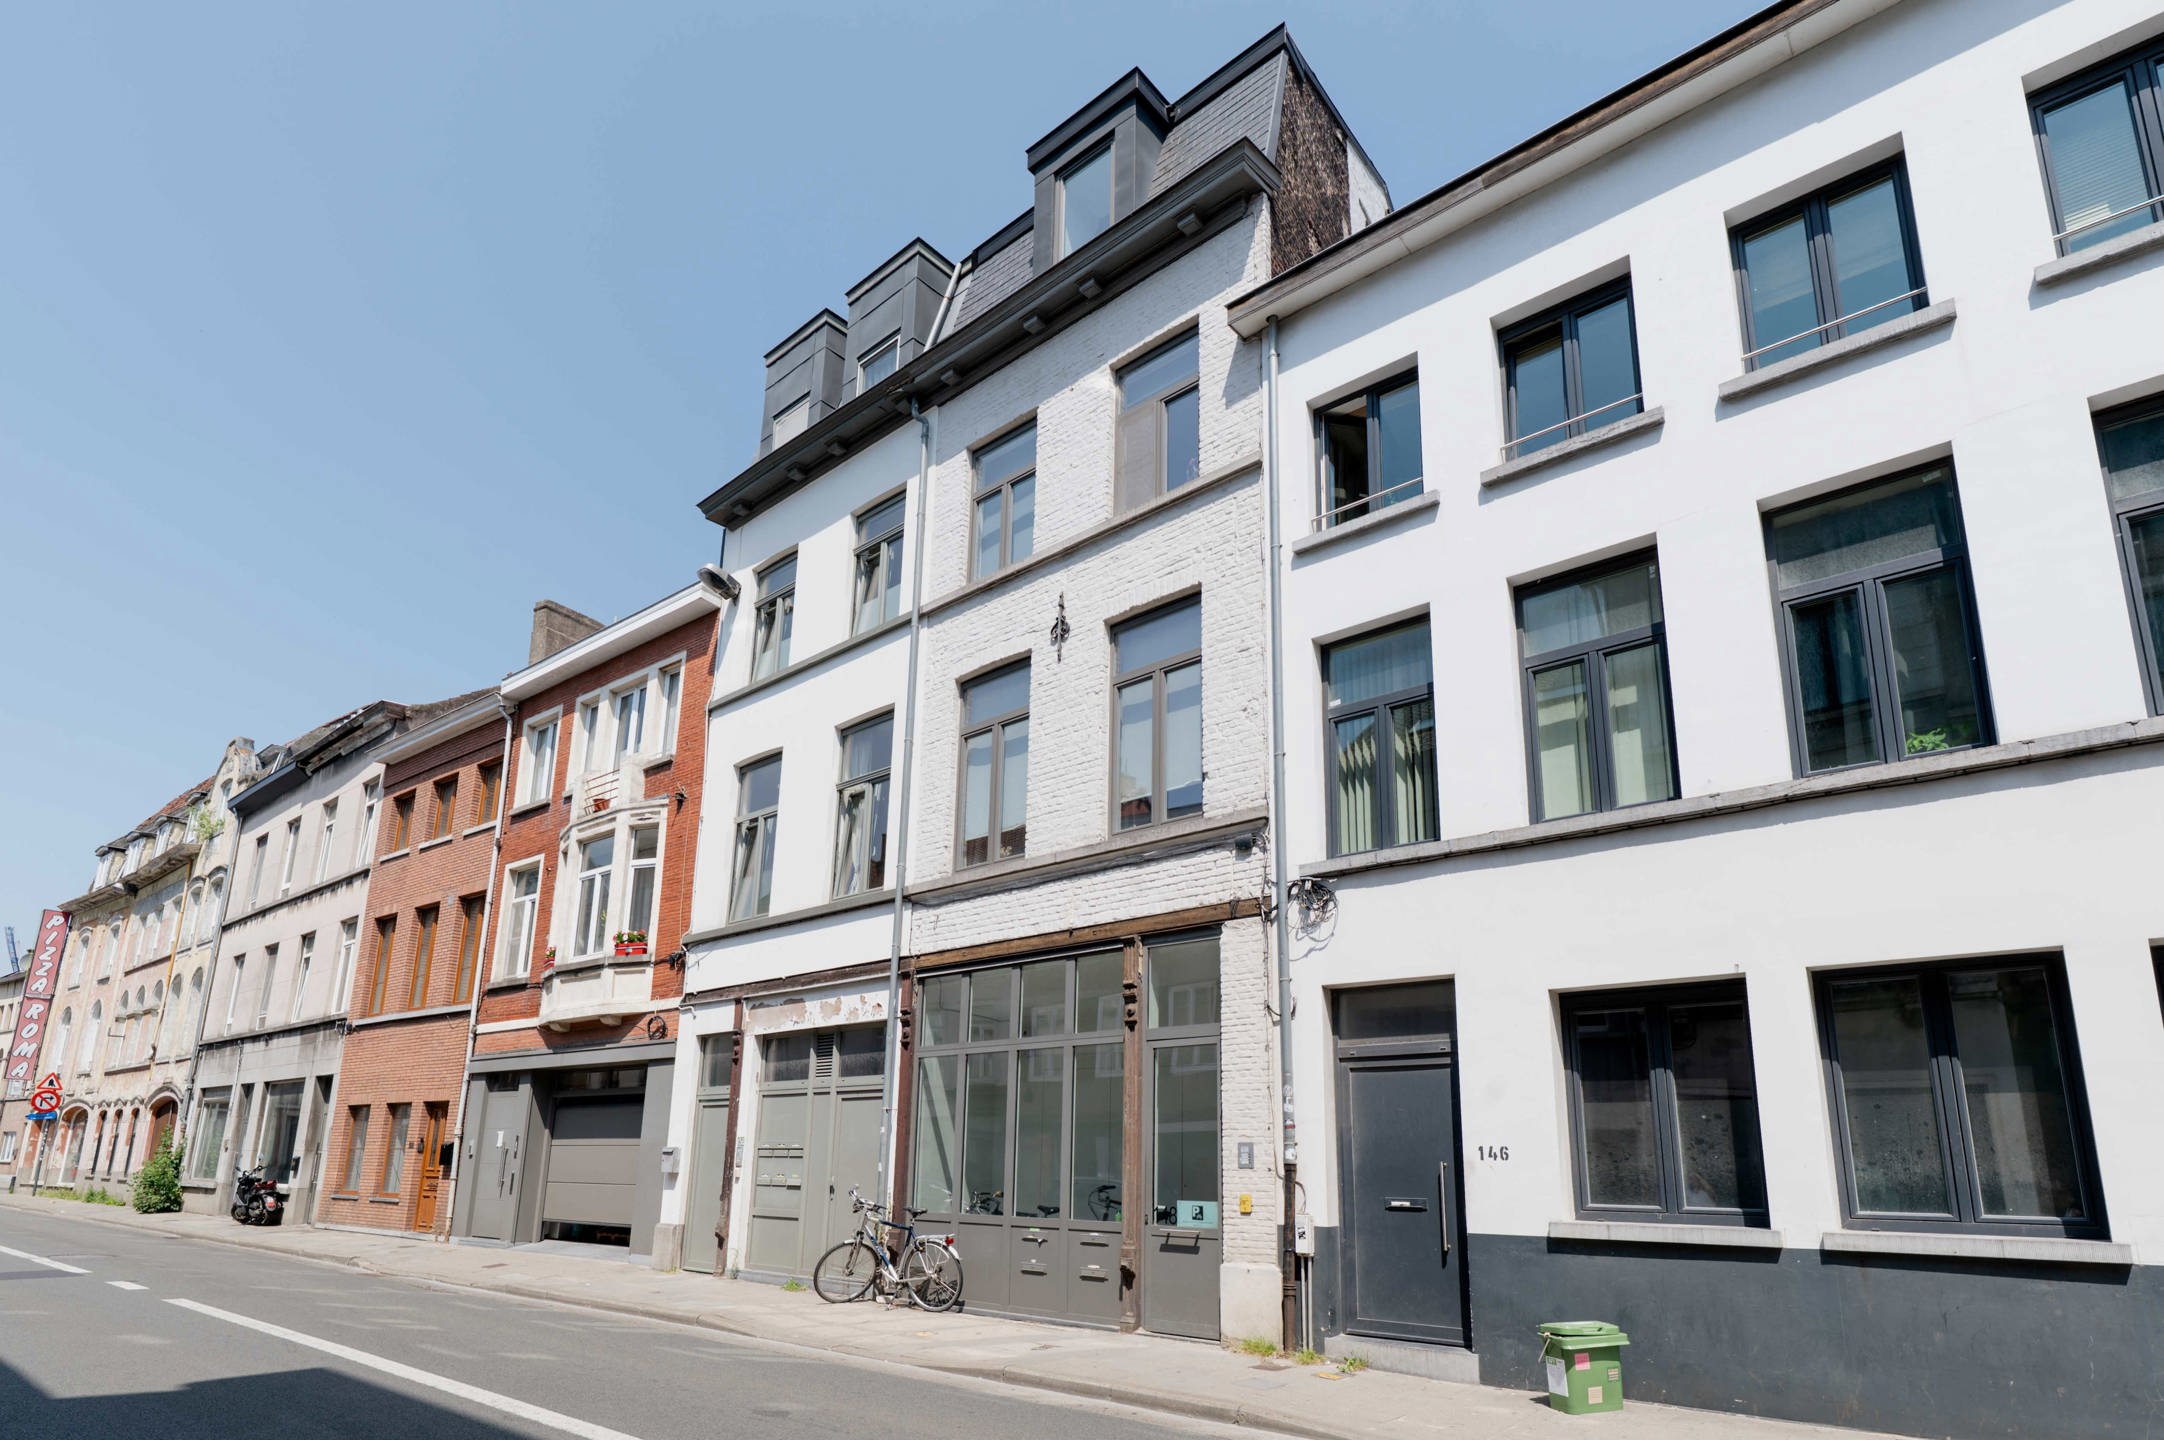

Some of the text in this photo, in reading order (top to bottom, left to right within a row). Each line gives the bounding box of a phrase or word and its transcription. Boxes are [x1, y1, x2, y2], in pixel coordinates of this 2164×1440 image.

[11, 915, 64, 1078] PIZZA ROMA
[1478, 1145, 1509, 1161] 146
